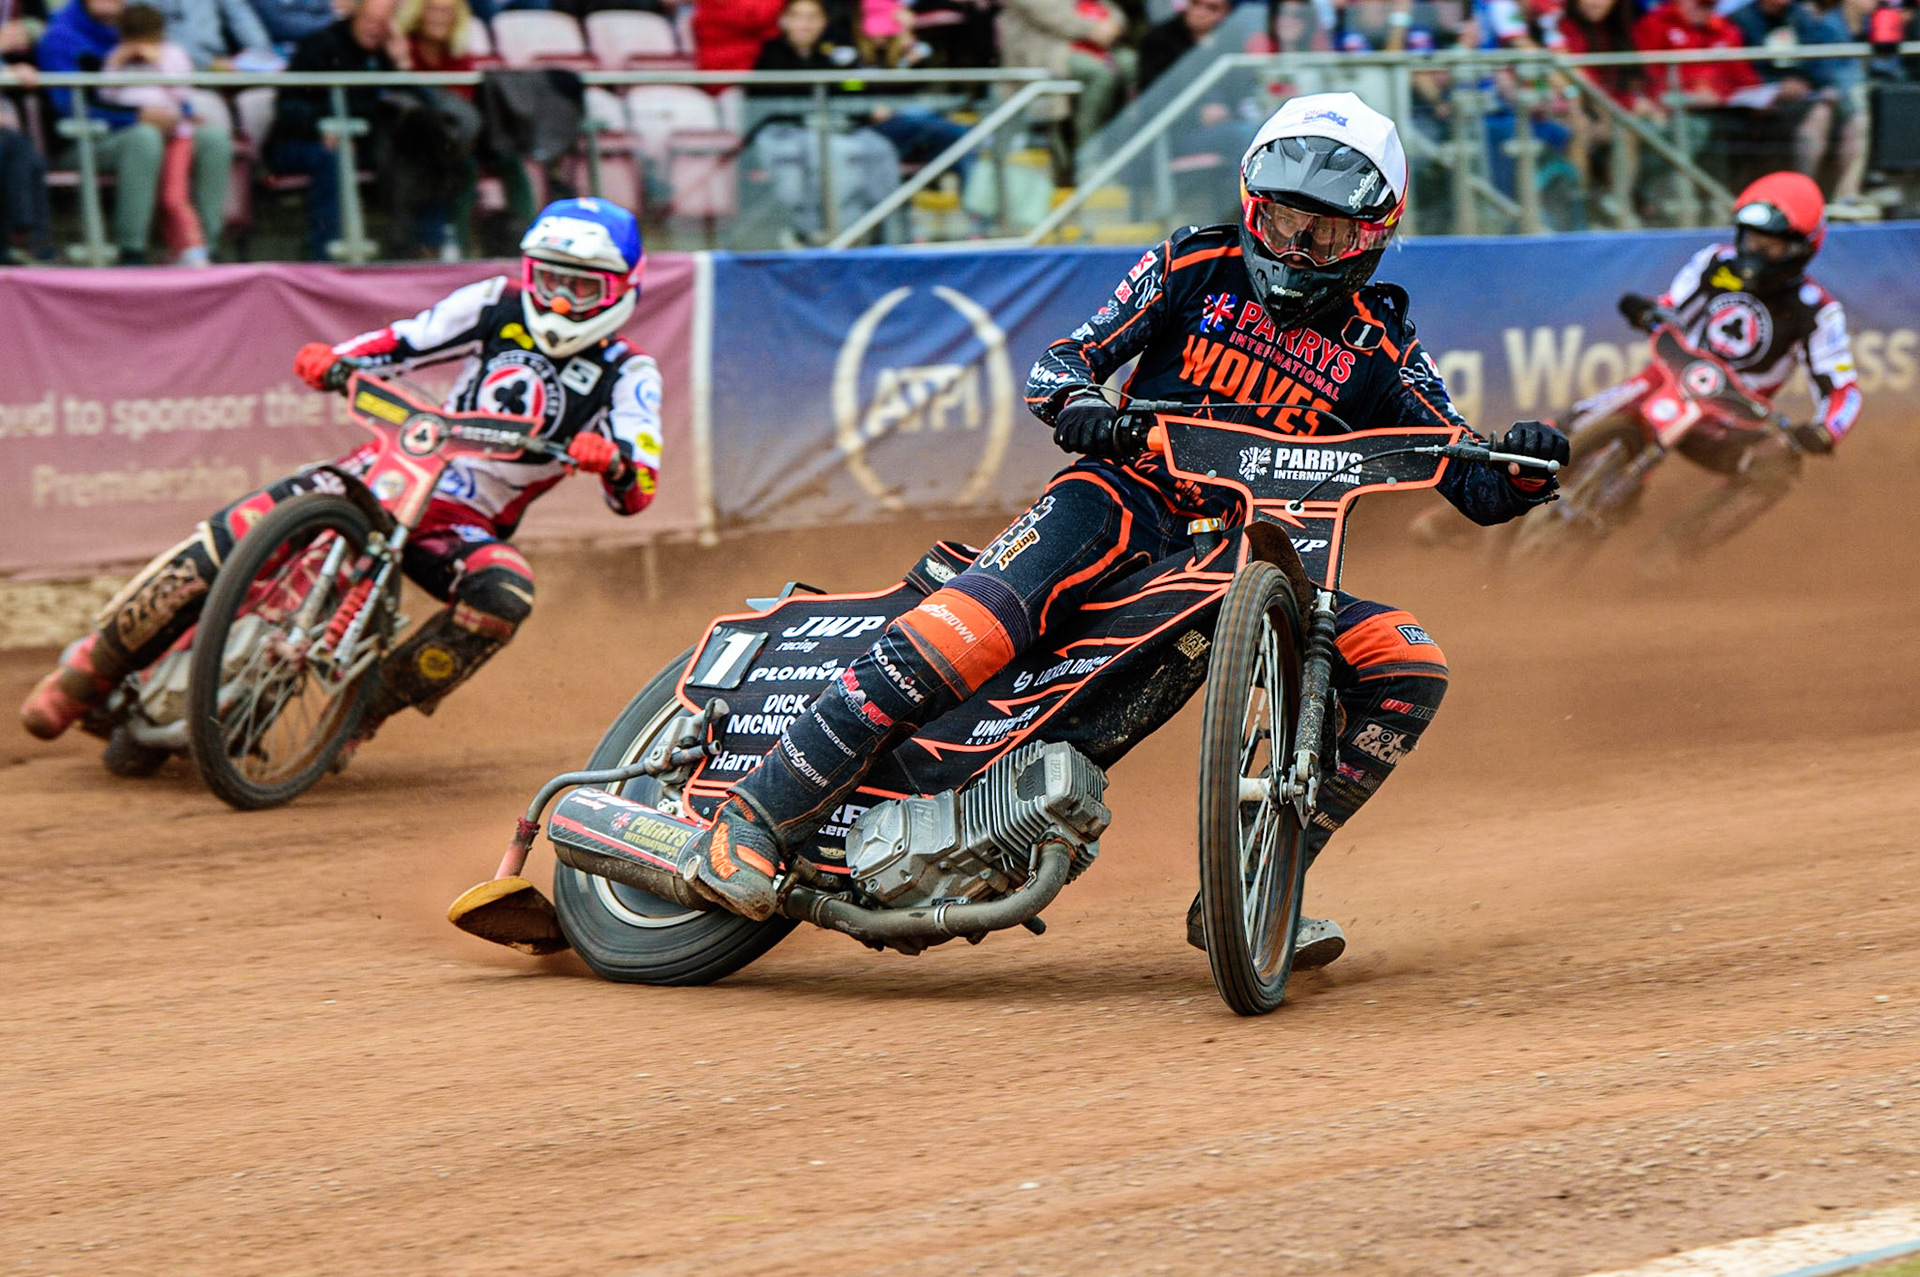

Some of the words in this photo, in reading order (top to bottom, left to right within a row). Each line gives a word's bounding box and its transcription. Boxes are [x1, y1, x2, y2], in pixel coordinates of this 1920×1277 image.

[1236, 300, 1356, 384] PARRYS
[1354, 324, 1372, 347] 1
[1229, 331, 1340, 401] INTERNATIONAL
[1179, 335, 1332, 436] WOLVES
[62, 393, 106, 436] to
[110, 396, 257, 442] sponsor
[263, 384, 327, 428] the
[1274, 448, 1363, 475] PARRYS
[1290, 538, 1328, 552] WP
[781, 615, 887, 638] JWP
[701, 631, 757, 686] 1
[775, 639, 820, 653] racing
[762, 694, 810, 714] DICK
[1380, 698, 1414, 714] UNI
[726, 714, 796, 735] MCNIC
[1351, 731, 1405, 765] RACIN
[628, 815, 693, 847] PARRYS
